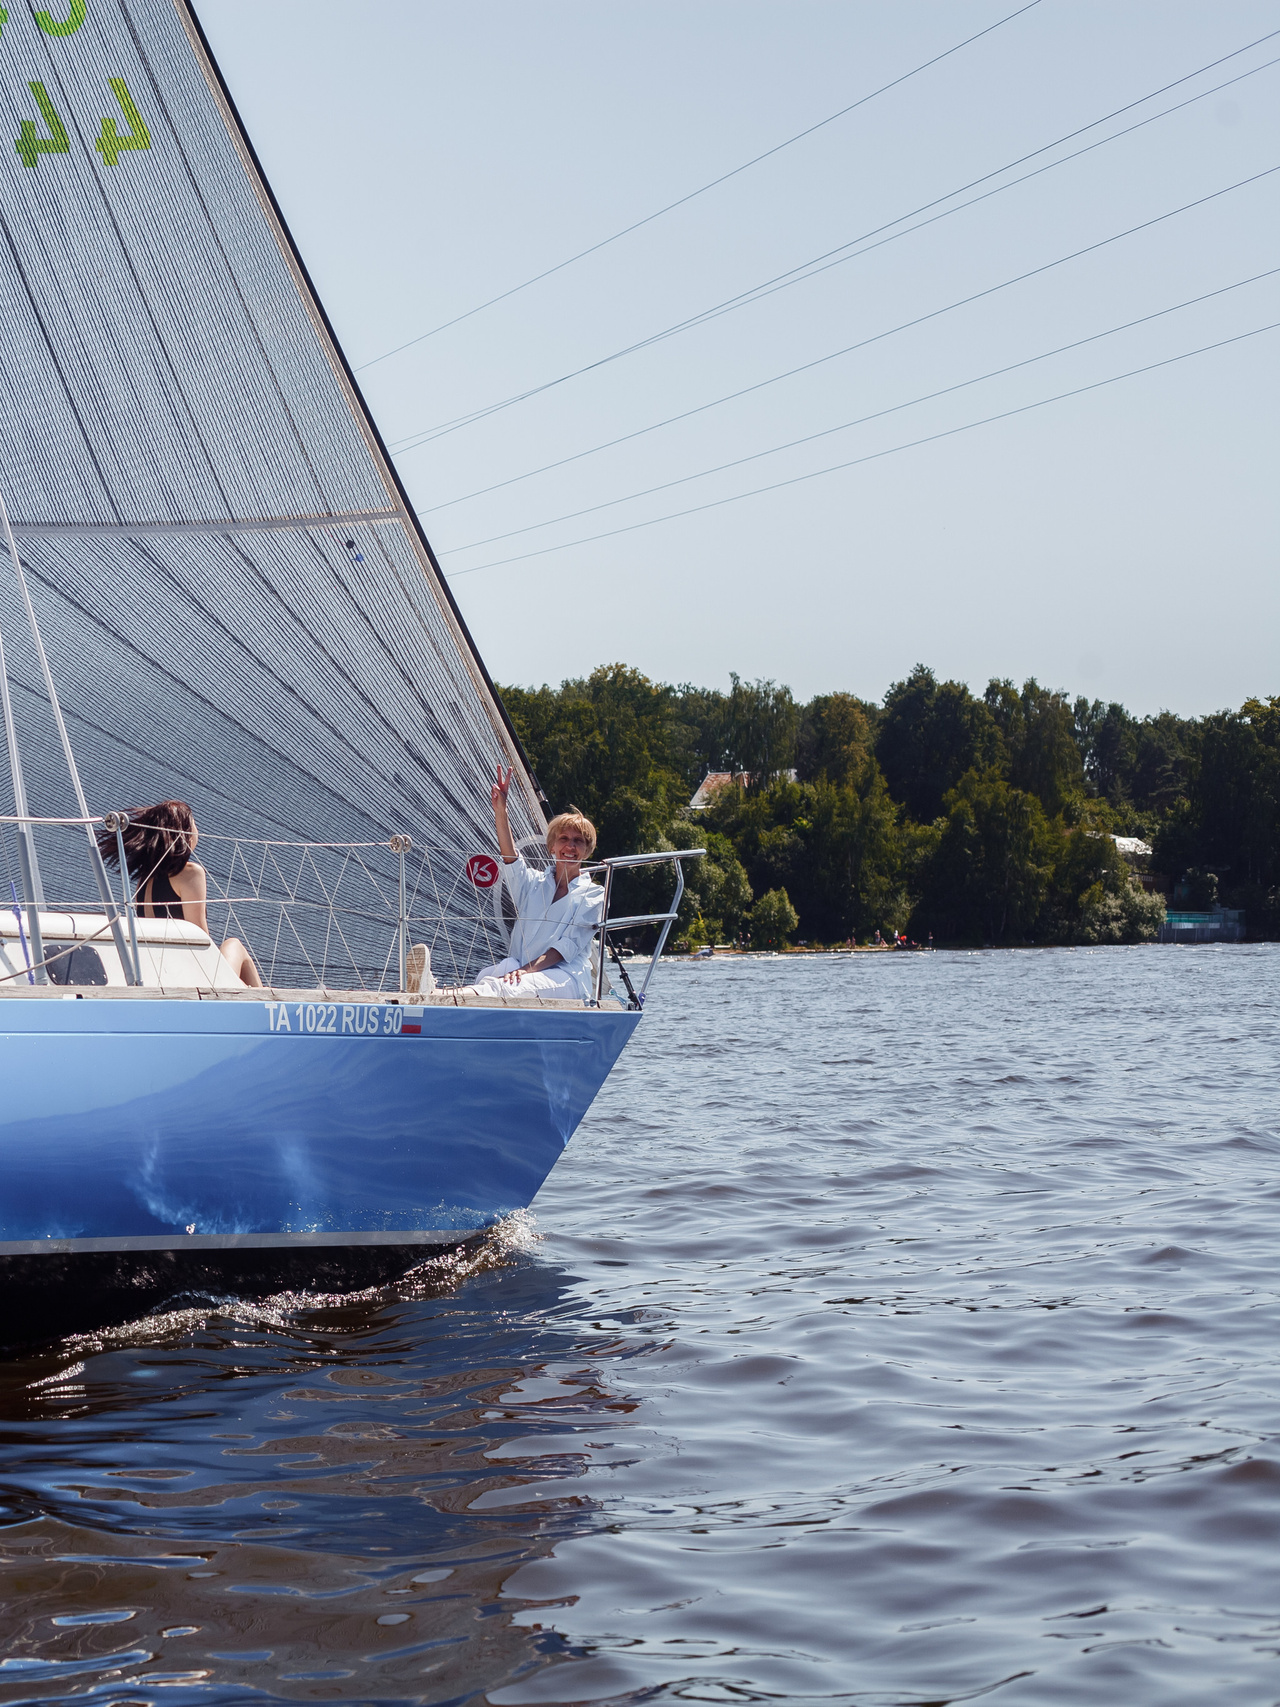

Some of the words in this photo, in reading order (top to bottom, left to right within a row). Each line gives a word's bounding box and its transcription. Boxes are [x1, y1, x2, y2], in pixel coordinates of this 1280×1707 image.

[295, 1005, 337, 1033] 1022
[342, 1006, 379, 1034] RUS
[383, 1008, 402, 1035] 50
